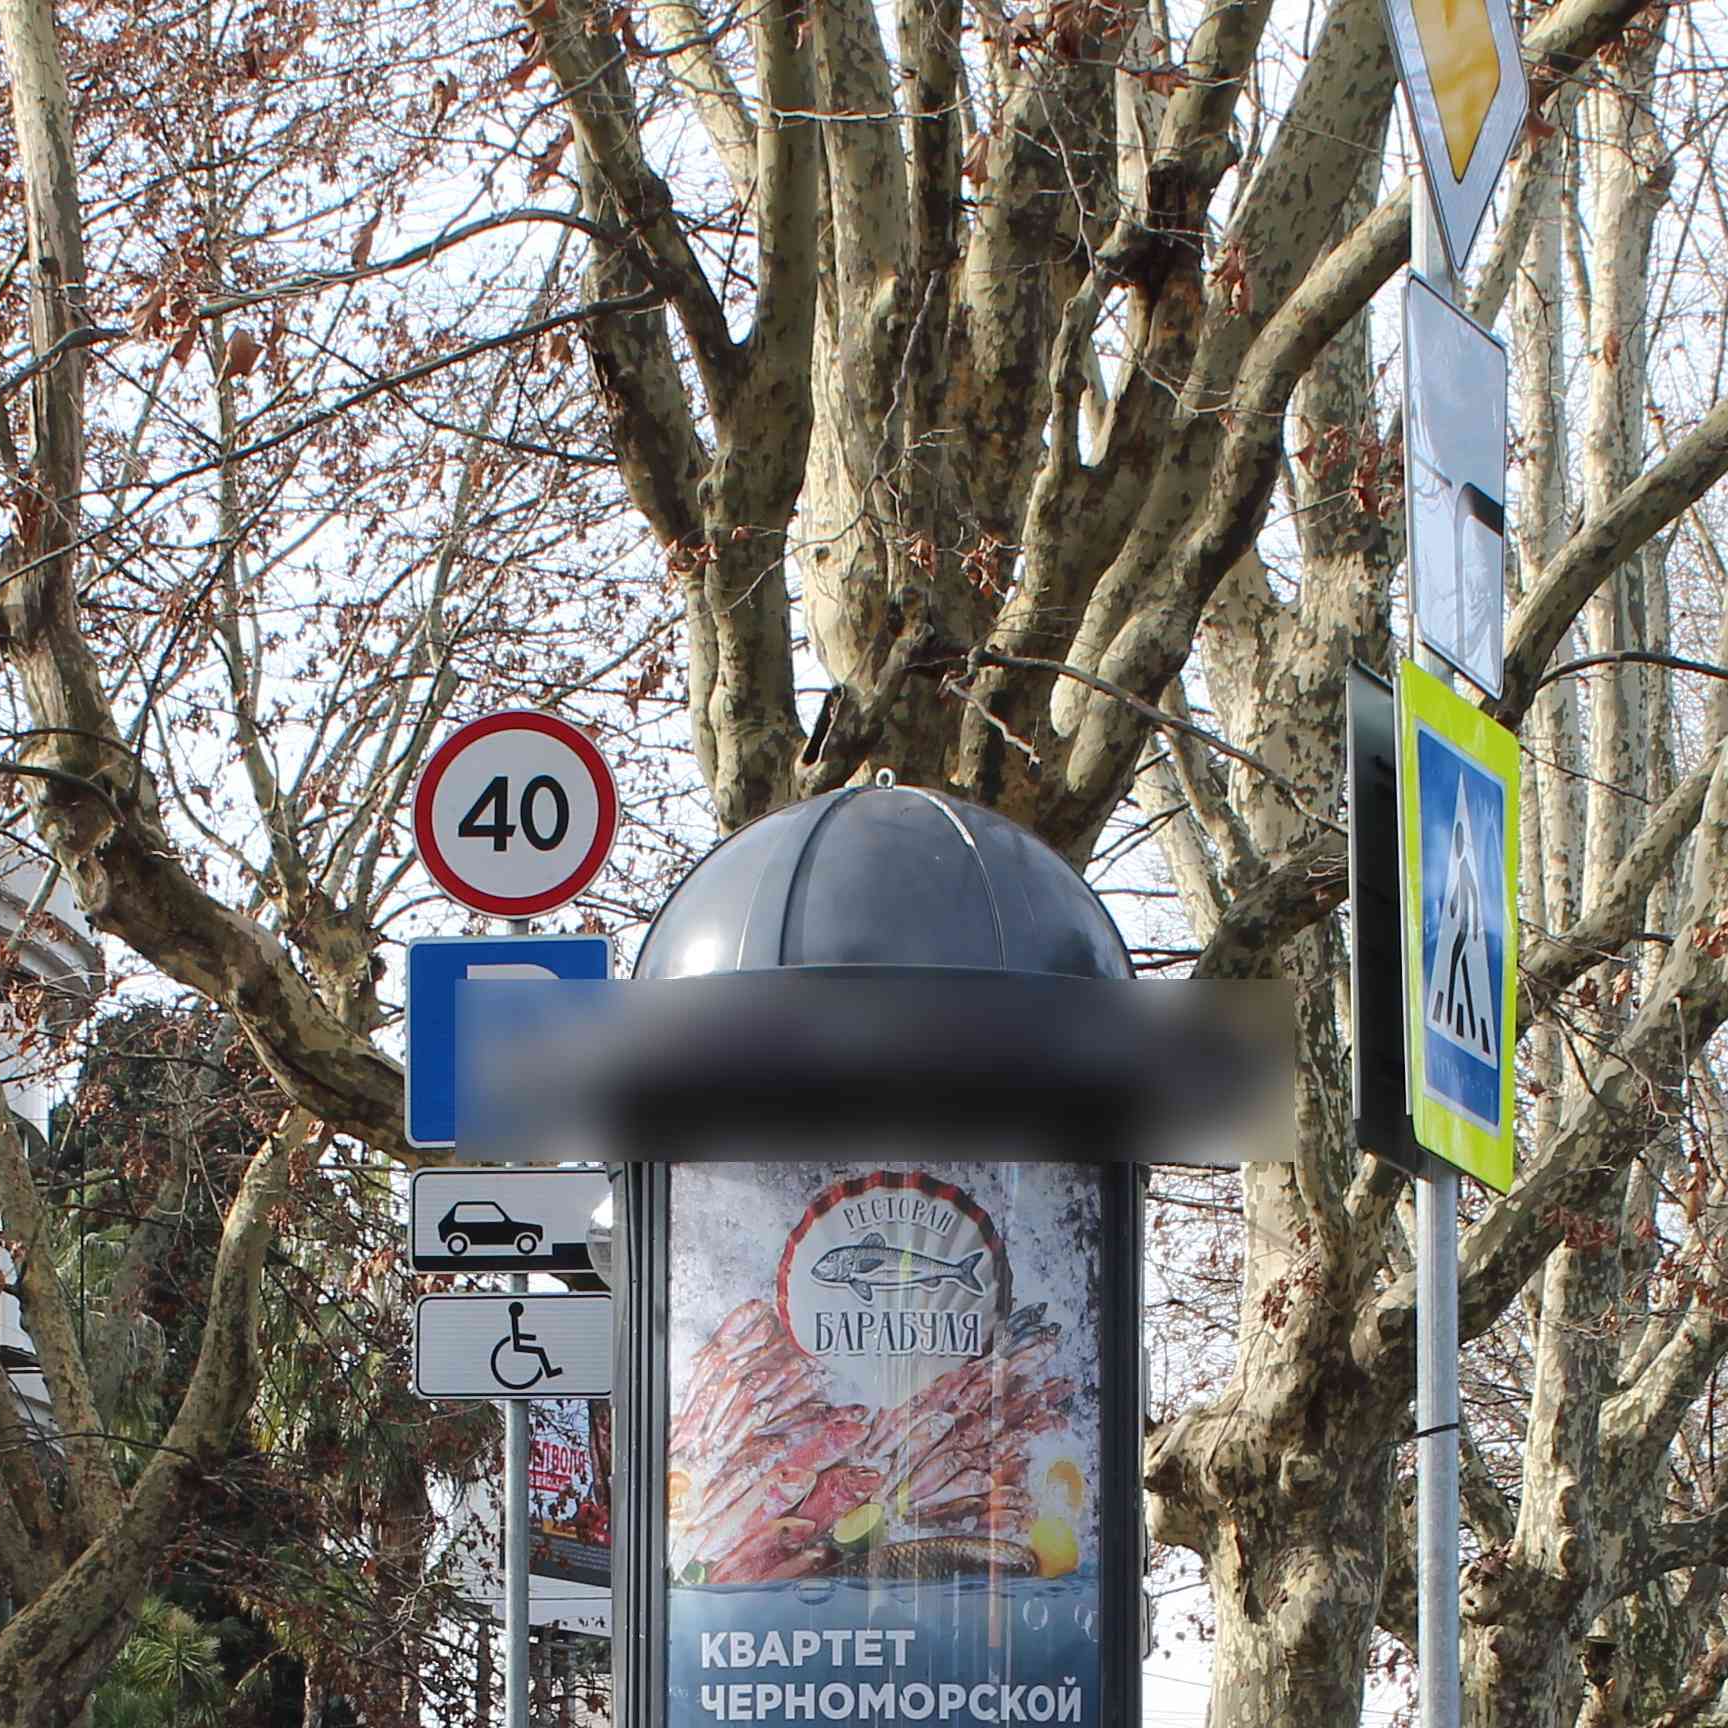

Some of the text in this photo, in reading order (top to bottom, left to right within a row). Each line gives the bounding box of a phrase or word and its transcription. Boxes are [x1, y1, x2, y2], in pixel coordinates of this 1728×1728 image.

[458, 774, 570, 852] 40
[842, 1195, 955, 1234] РЕСТОРАН
[815, 1309, 982, 1357] БАРАБУЛЯ
[700, 1630, 916, 1669] КВАРТЕТ
[701, 1676, 1082, 1722] ЧЕРНОМОРСКОЙ
